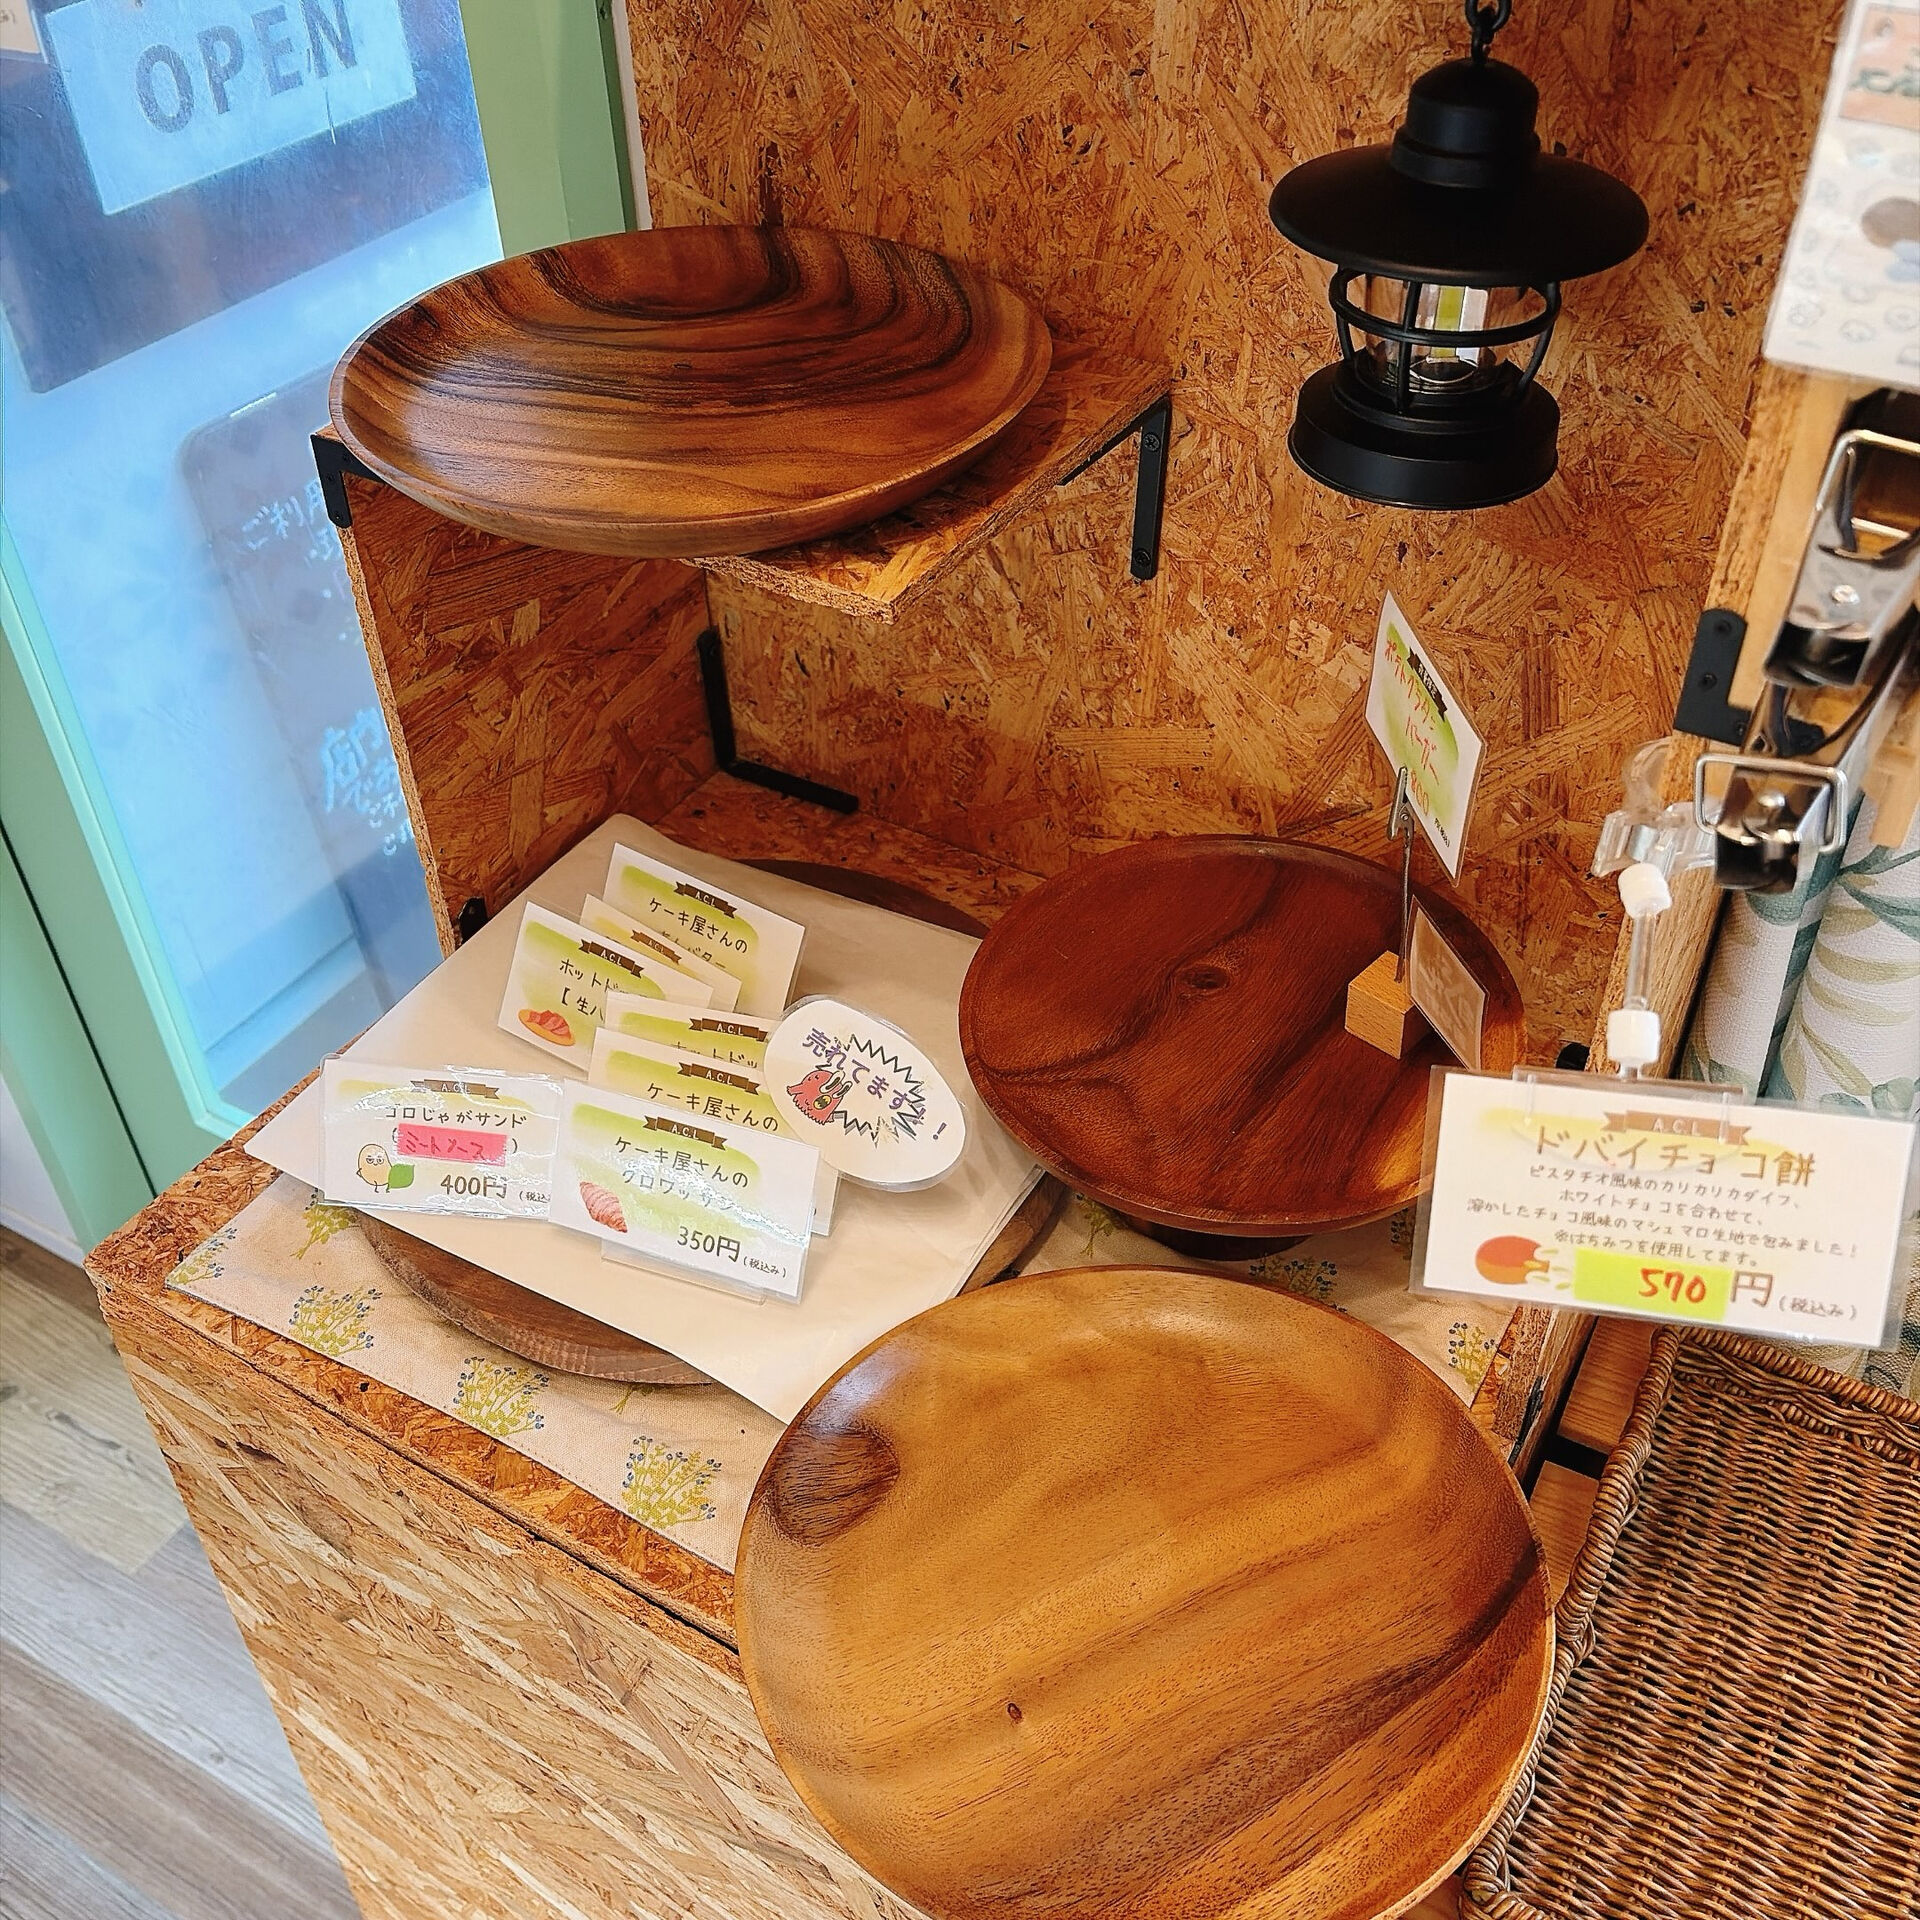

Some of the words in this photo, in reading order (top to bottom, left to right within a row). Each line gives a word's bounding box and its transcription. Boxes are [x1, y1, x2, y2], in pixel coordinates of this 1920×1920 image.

[135, 0, 357, 133] OPEN
[694, 890, 716, 908] A.C.L
[649, 897, 749, 953] ケーキ屋さんの
[600, 949, 623, 966] A.C.L
[716, 1022, 745, 1037] A.C.L
[705, 1069, 734, 1086] A.C.L
[385, 1103, 527, 1129] ゴロじゃがサンド
[647, 1082, 779, 1132] ケーキ屋さんの
[671, 1124, 701, 1140] A.C.L
[614, 1136, 749, 1188] ケーキ屋さんの
[1536, 1125, 1816, 1187] ドバイチョコ餅
[440, 1173, 508, 1198] 400円
[518, 1190, 551, 1204] （税込
[622, 1168, 735, 1212] クロワッサン
[1530, 1164, 1800, 1209] ピスタチオ風味のカリカリカダイフ、
[1558, 1189, 1763, 1226] ホワイトチョコを合わせて、
[676, 1225, 741, 1264] 350円
[1466, 1198, 1857, 1258] 溶かしたチョコ風味のマシュマロ生地で包みました！
[1555, 1228, 1758, 1267] ※はちみつを使用してます。
[743, 1257, 787, 1279] （税込み）
[1779, 1295, 1858, 1320] （税込み）
